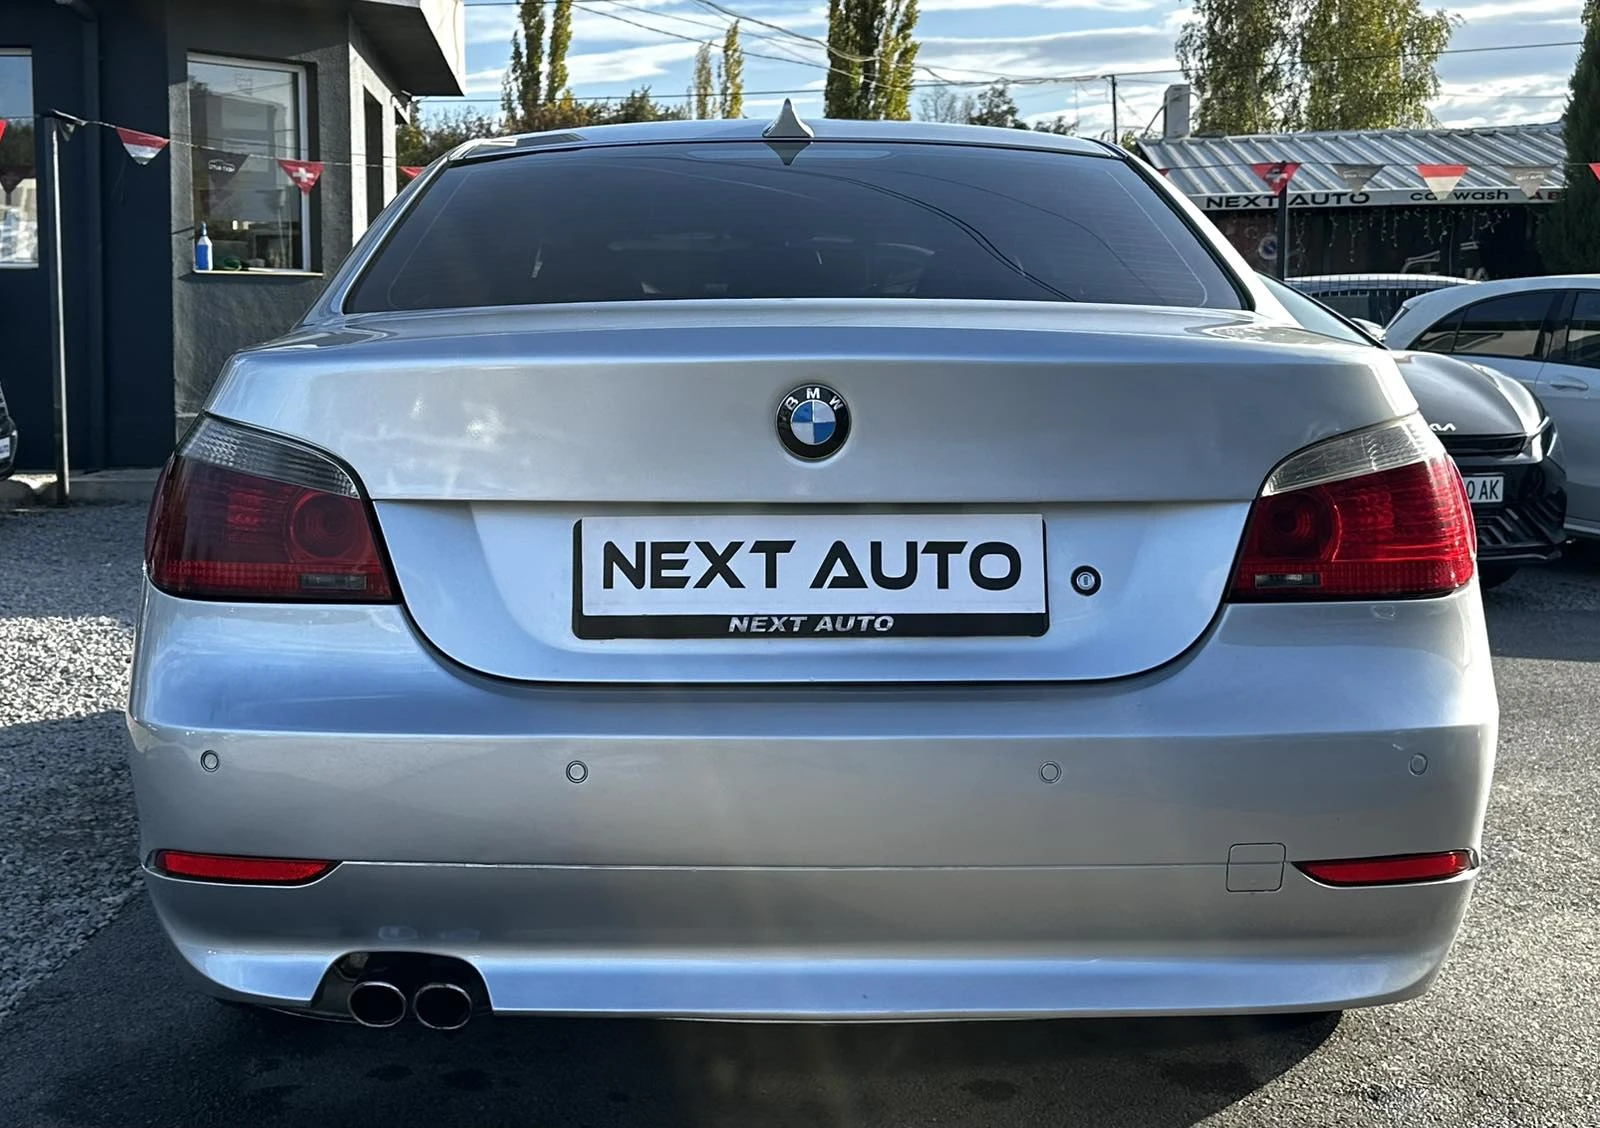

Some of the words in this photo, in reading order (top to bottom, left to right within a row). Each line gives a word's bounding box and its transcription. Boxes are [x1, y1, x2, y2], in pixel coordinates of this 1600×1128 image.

[1206, 195, 1279, 208] NEXT
[1288, 192, 1370, 205] AUTO
[1453, 190, 1509, 201] wash
[785, 387, 844, 411] BMW
[1478, 479, 1500, 501] AK
[603, 540, 796, 589] NEXT
[809, 540, 1022, 590] AUTO
[728, 616, 808, 633] NEXT
[814, 615, 894, 633] AUTO
